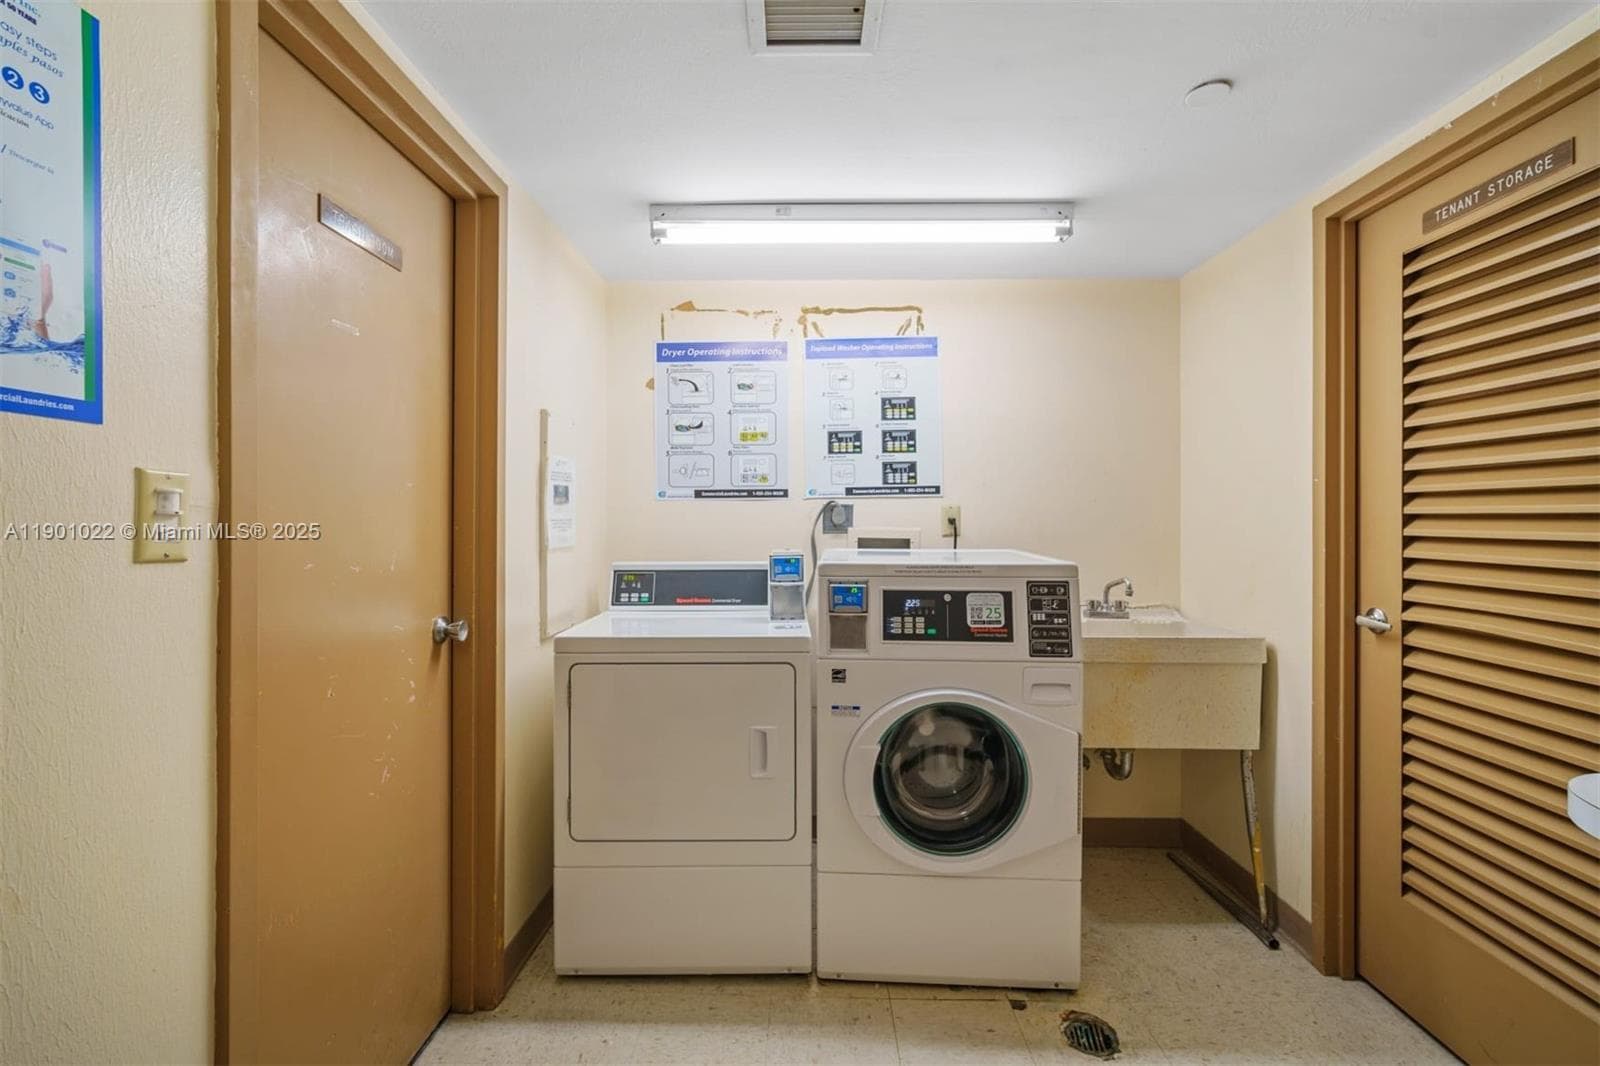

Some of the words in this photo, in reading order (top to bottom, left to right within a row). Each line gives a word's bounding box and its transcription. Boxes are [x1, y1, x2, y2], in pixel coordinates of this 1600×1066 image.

[26, 36, 58, 61] steps
[31, 55, 64, 78] pasos
[1434, 190, 1480, 222] TENANT
[1487, 154, 1553, 197] STORAGE
[662, 348, 686, 358] Dryer
[687, 347, 731, 357] Operating
[731, 346, 783, 356] Instructions
[861, 343, 894, 352] Operating
[985, 607, 1002, 619] 25
